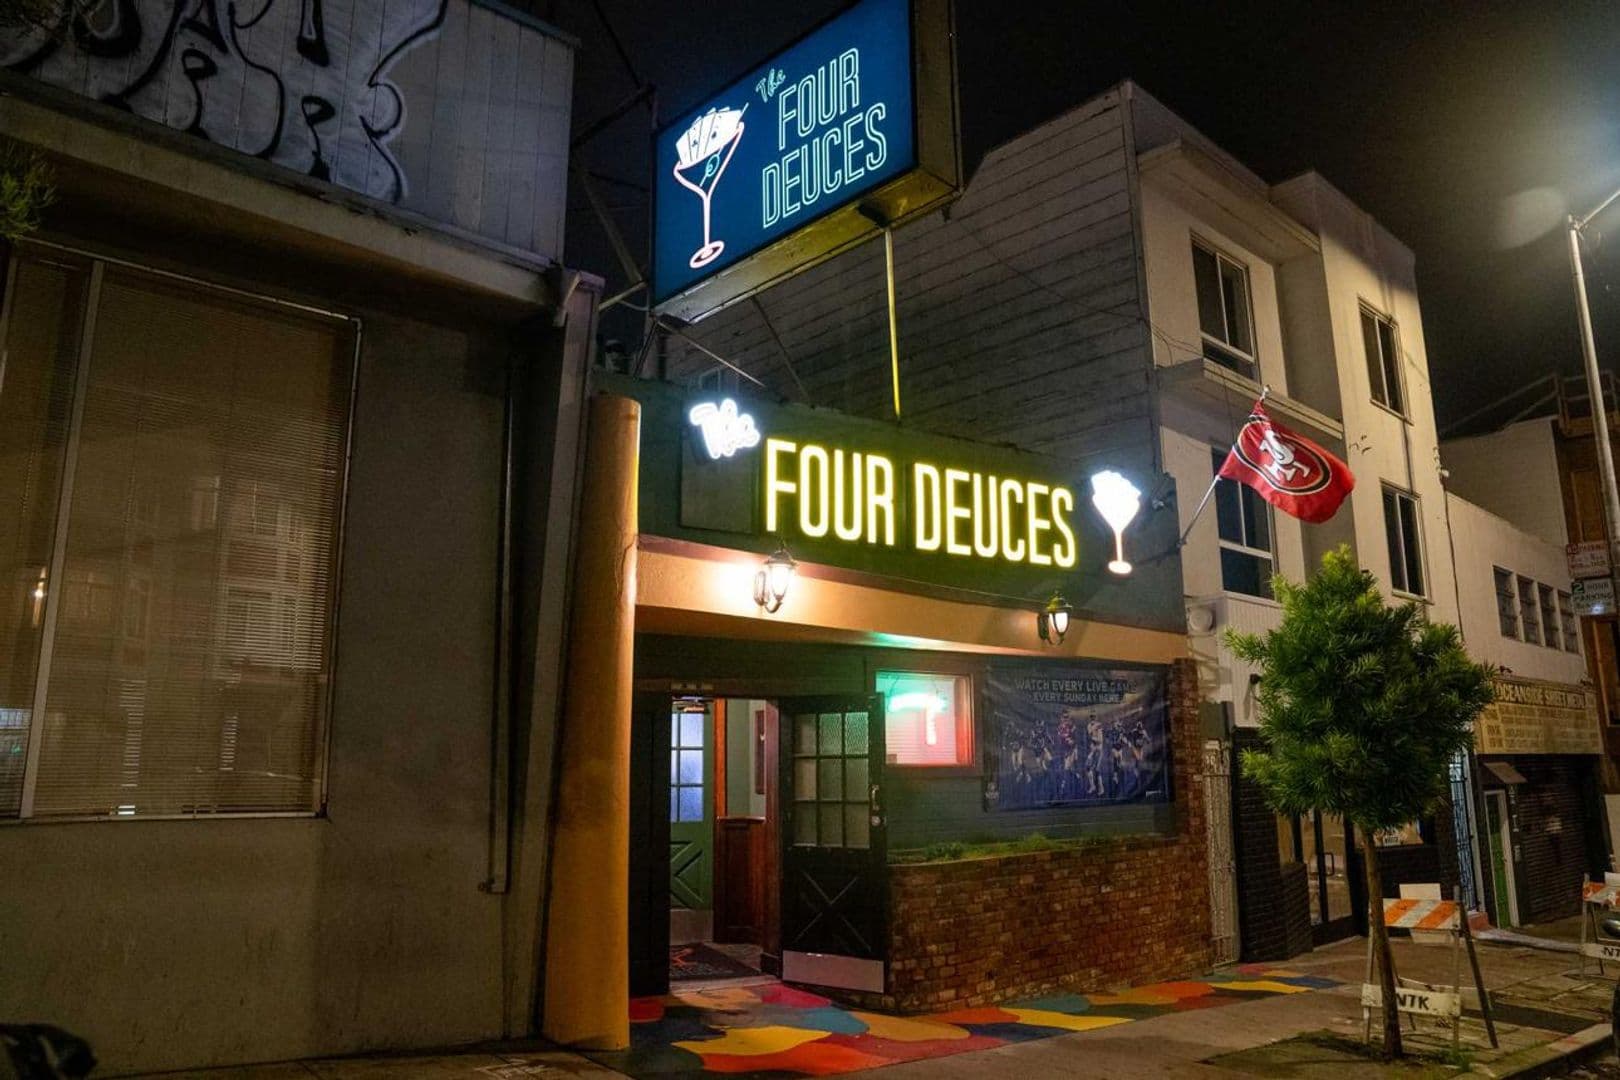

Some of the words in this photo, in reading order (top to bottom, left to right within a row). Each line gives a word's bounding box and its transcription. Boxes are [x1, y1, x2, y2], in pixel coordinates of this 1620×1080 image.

[755, 68, 786, 103] The
[778, 47, 860, 151] FOUR
[762, 102, 887, 229] DEUCES
[689, 397, 761, 460] The
[765, 437, 896, 546] FOUR
[912, 462, 1077, 569] DEUCES
[1573, 582, 1583, 592] 2
[1015, 679, 1050, 691] WATCH
[1052, 680, 1083, 692] EVERY
[1086, 681, 1107, 693] LIVE
